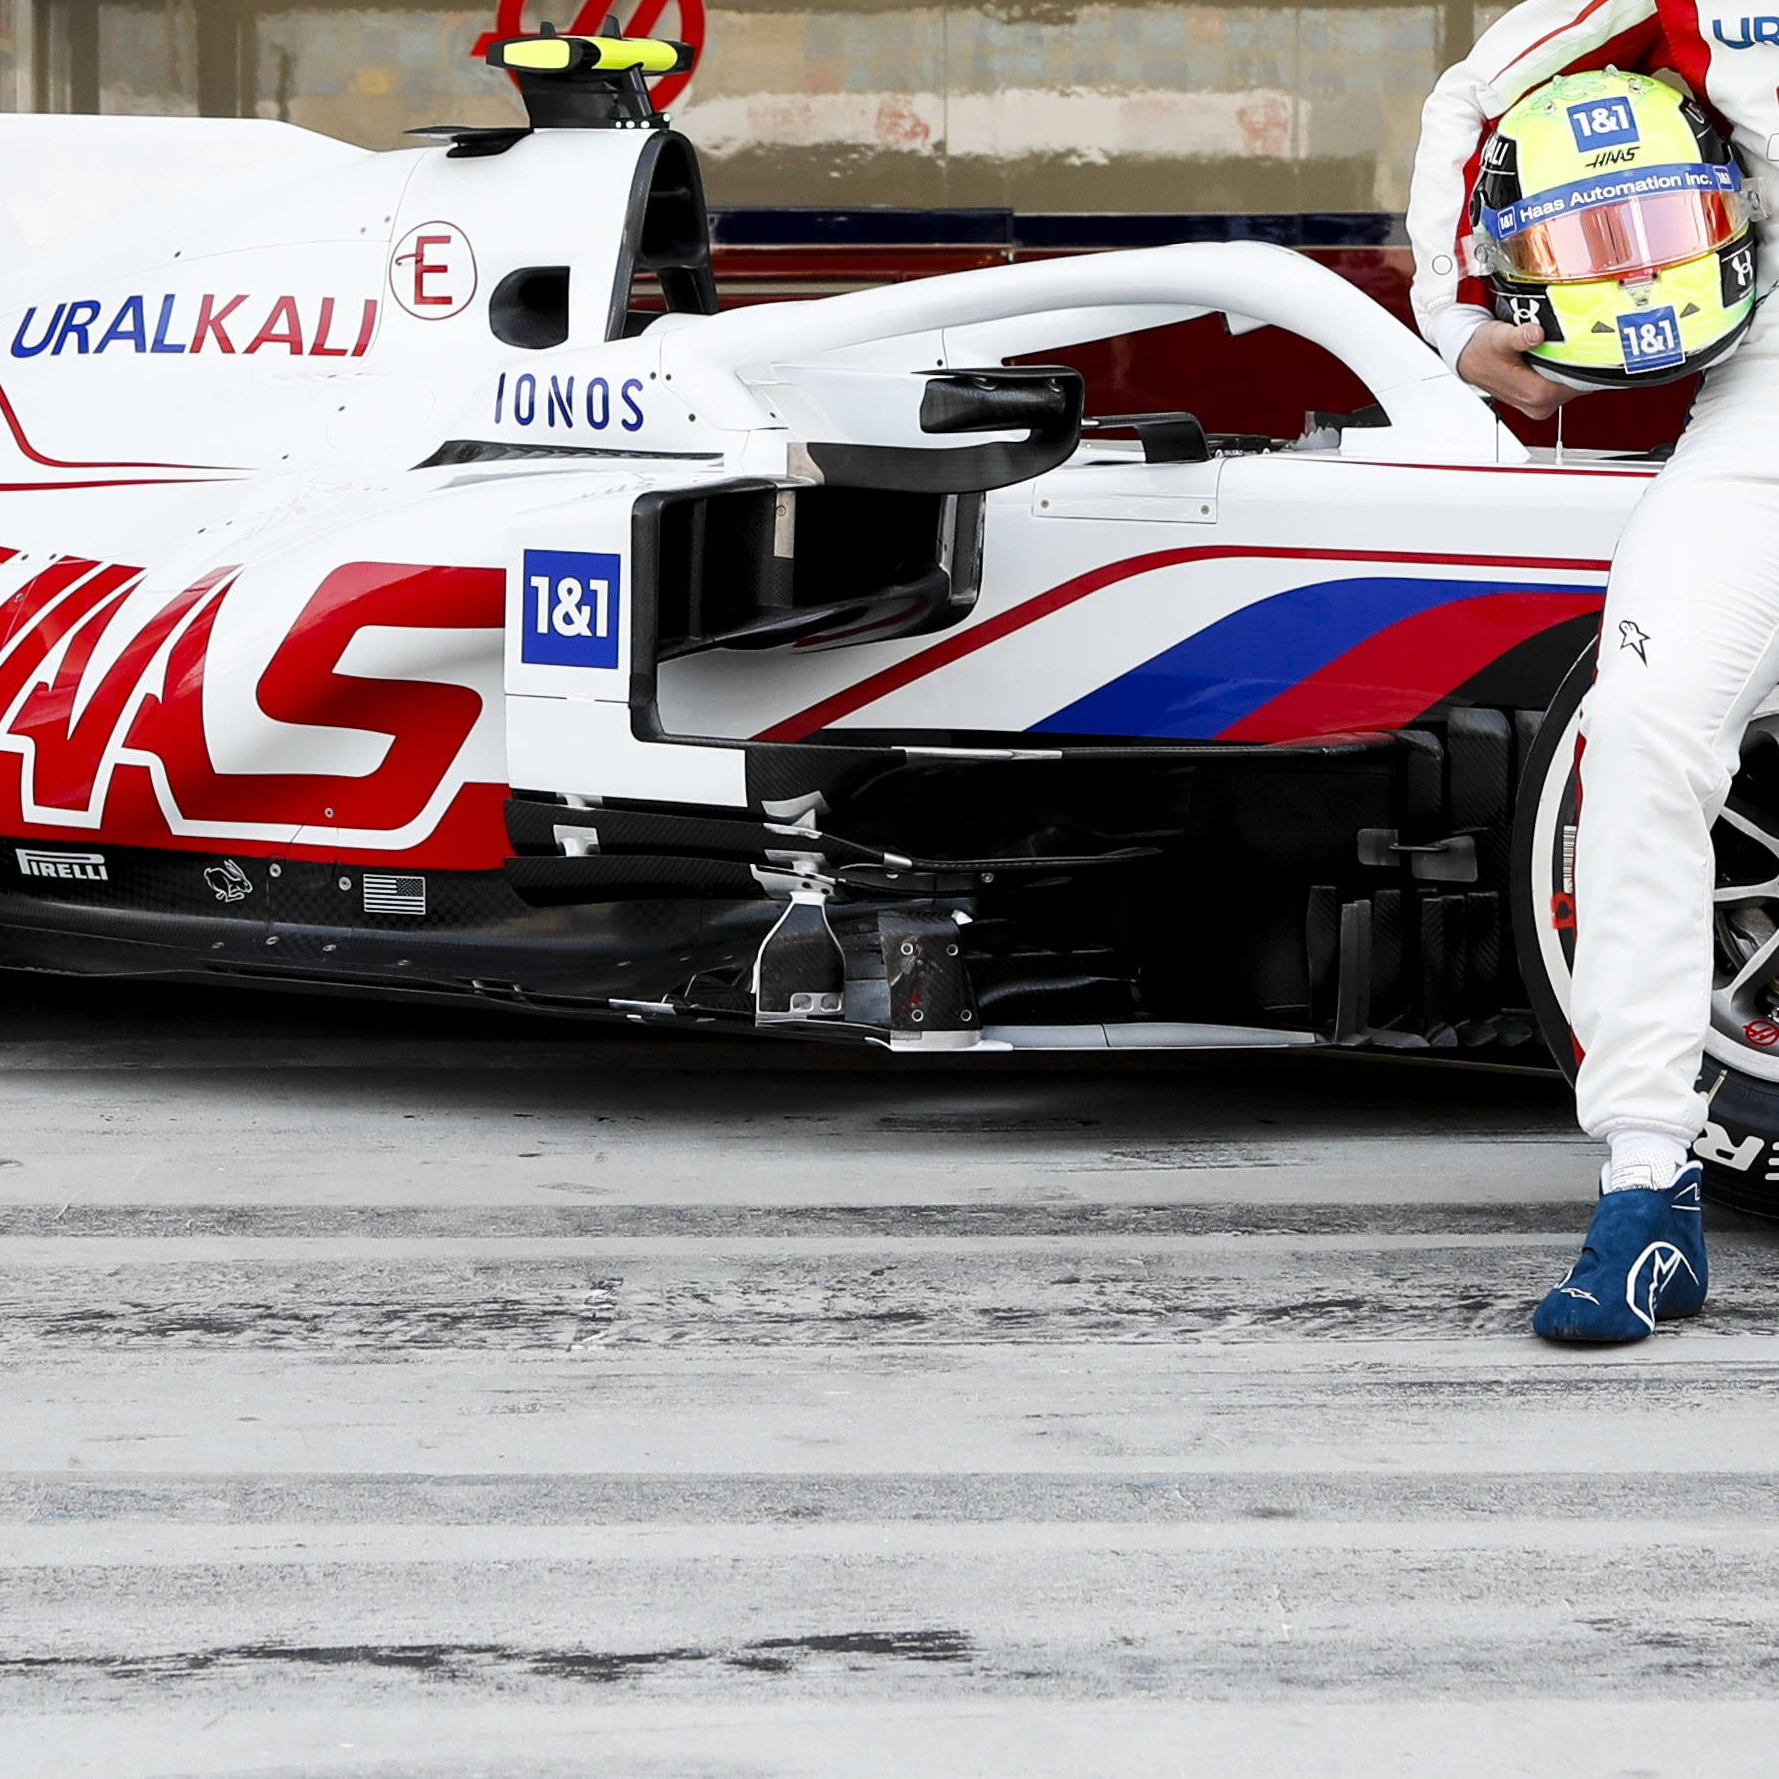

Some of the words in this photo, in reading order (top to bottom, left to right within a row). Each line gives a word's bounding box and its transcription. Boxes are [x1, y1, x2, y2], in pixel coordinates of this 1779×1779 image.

[1573, 104, 1631, 137] 1&1
[1584, 146, 1640, 169] HAAS
[1520, 198, 1565, 224] Haas
[1570, 175, 1683, 207] Automation
[1685, 172, 1713, 187] Inc.
[10, 293, 378, 359] URALKALI
[1623, 319, 1676, 356] 1&1
[493, 372, 645, 432] IONOS
[529, 575, 609, 639] 1&1
[14, 847, 109, 881] PIRELLI
